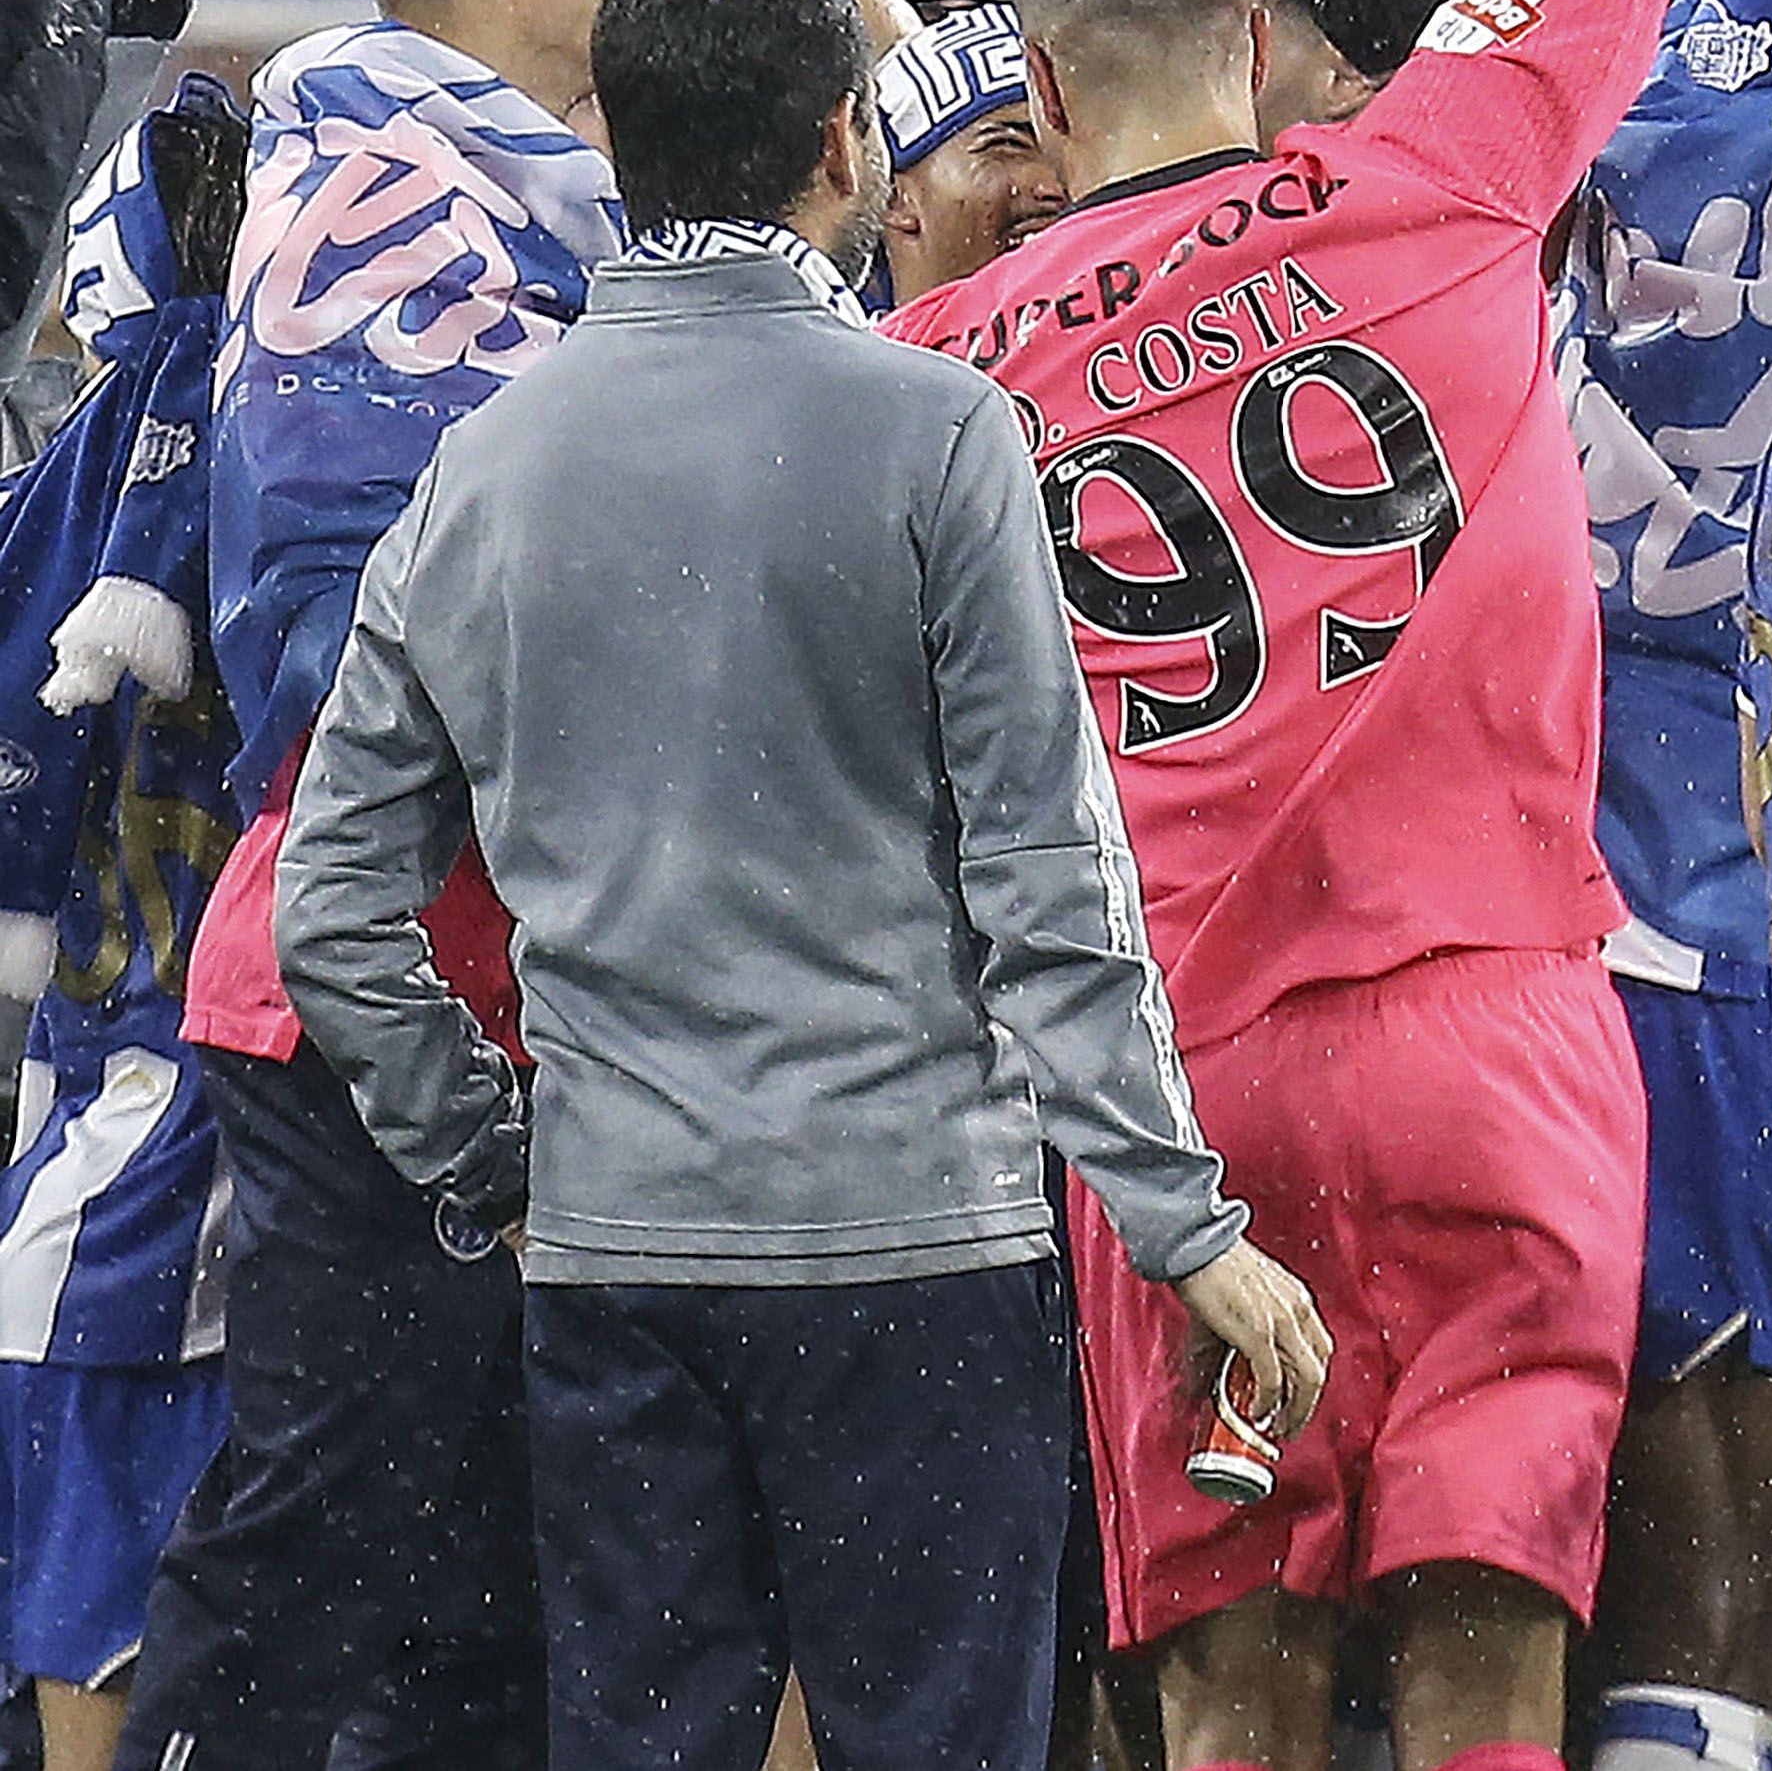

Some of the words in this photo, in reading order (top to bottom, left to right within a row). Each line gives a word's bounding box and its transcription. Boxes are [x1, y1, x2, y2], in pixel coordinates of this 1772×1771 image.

[928, 259, 1142, 369] UPER
[1085, 256, 1346, 415] COSTA
[1036, 339, 1467, 757] 99
